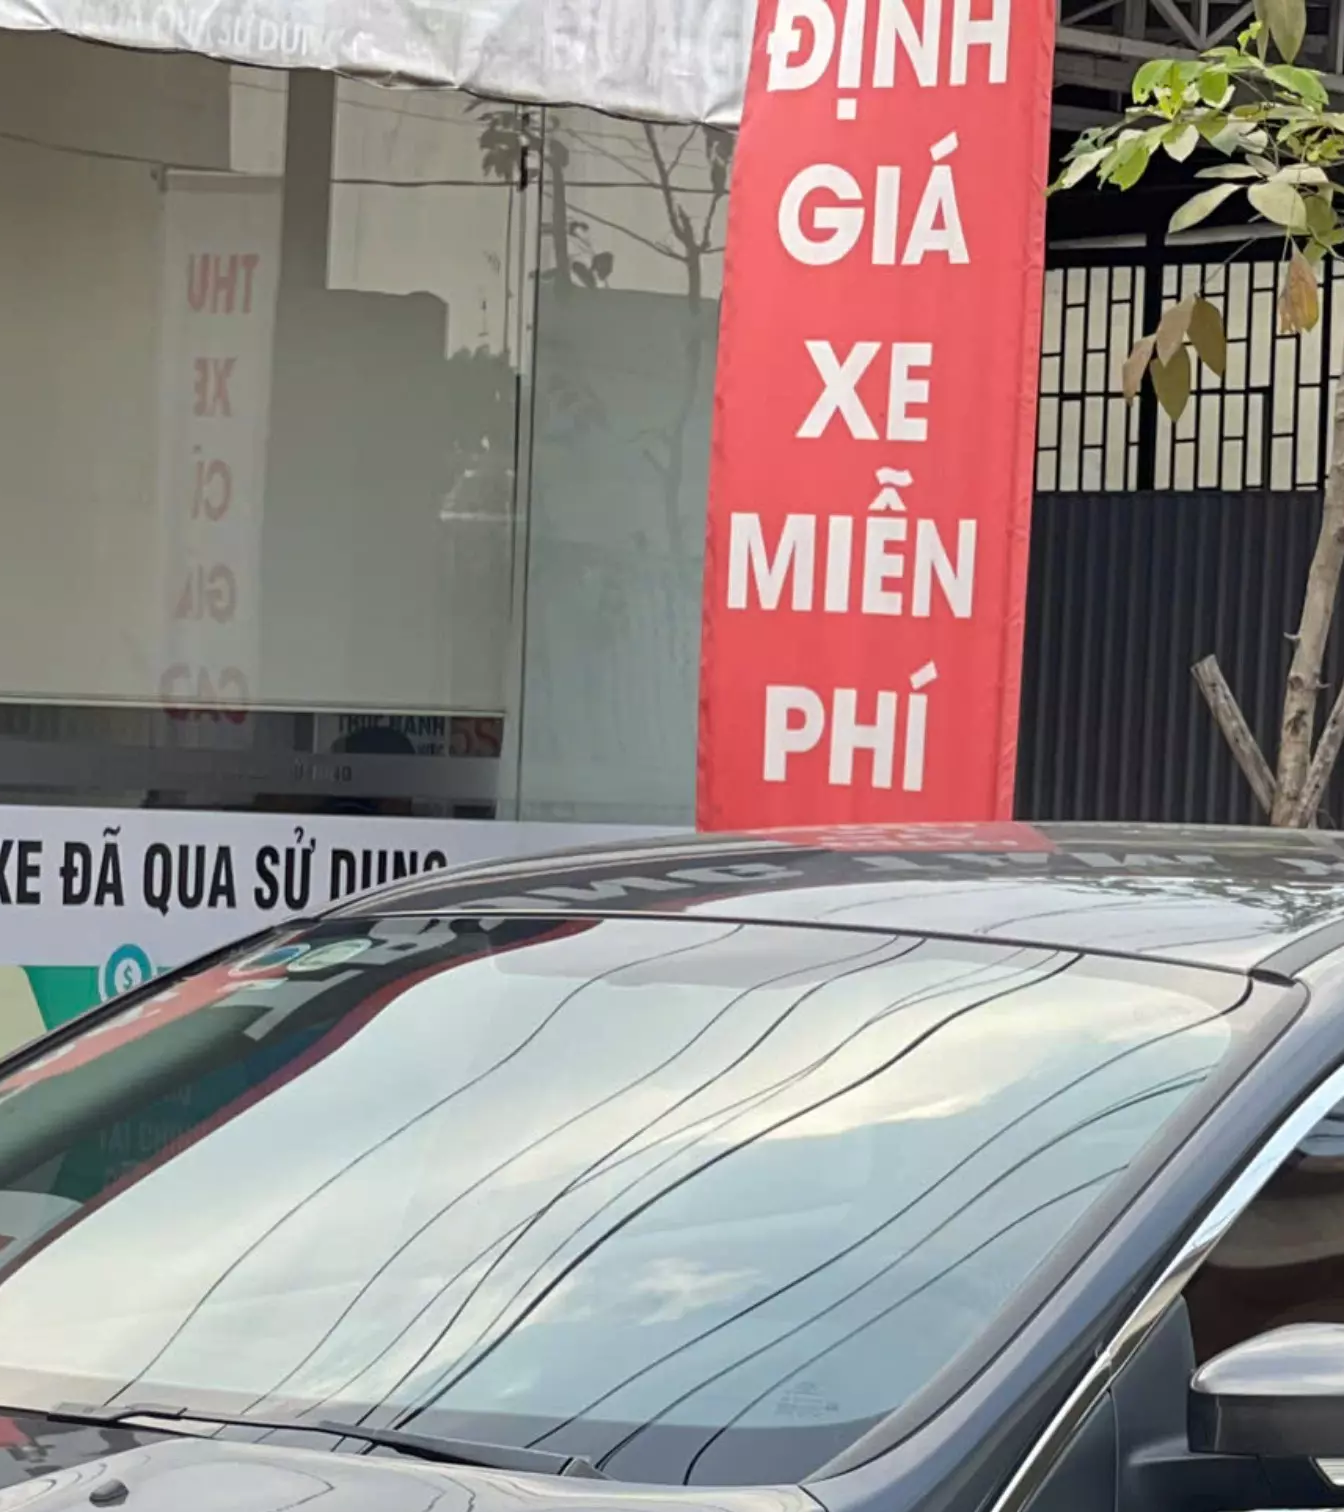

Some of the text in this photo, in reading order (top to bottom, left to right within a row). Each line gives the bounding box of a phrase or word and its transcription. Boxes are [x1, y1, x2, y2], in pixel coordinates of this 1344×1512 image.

[765, 0, 1011, 121] ĐỊNH
[777, 131, 971, 267] GIÁ
[795, 340, 934, 443] XE
[726, 466, 978, 619] MIỄN
[762, 660, 939, 793] PHÍ
[60, 826, 125, 907] ĐÃ
[142, 842, 237, 917] QUA
[254, 826, 318, 910] SỬ
